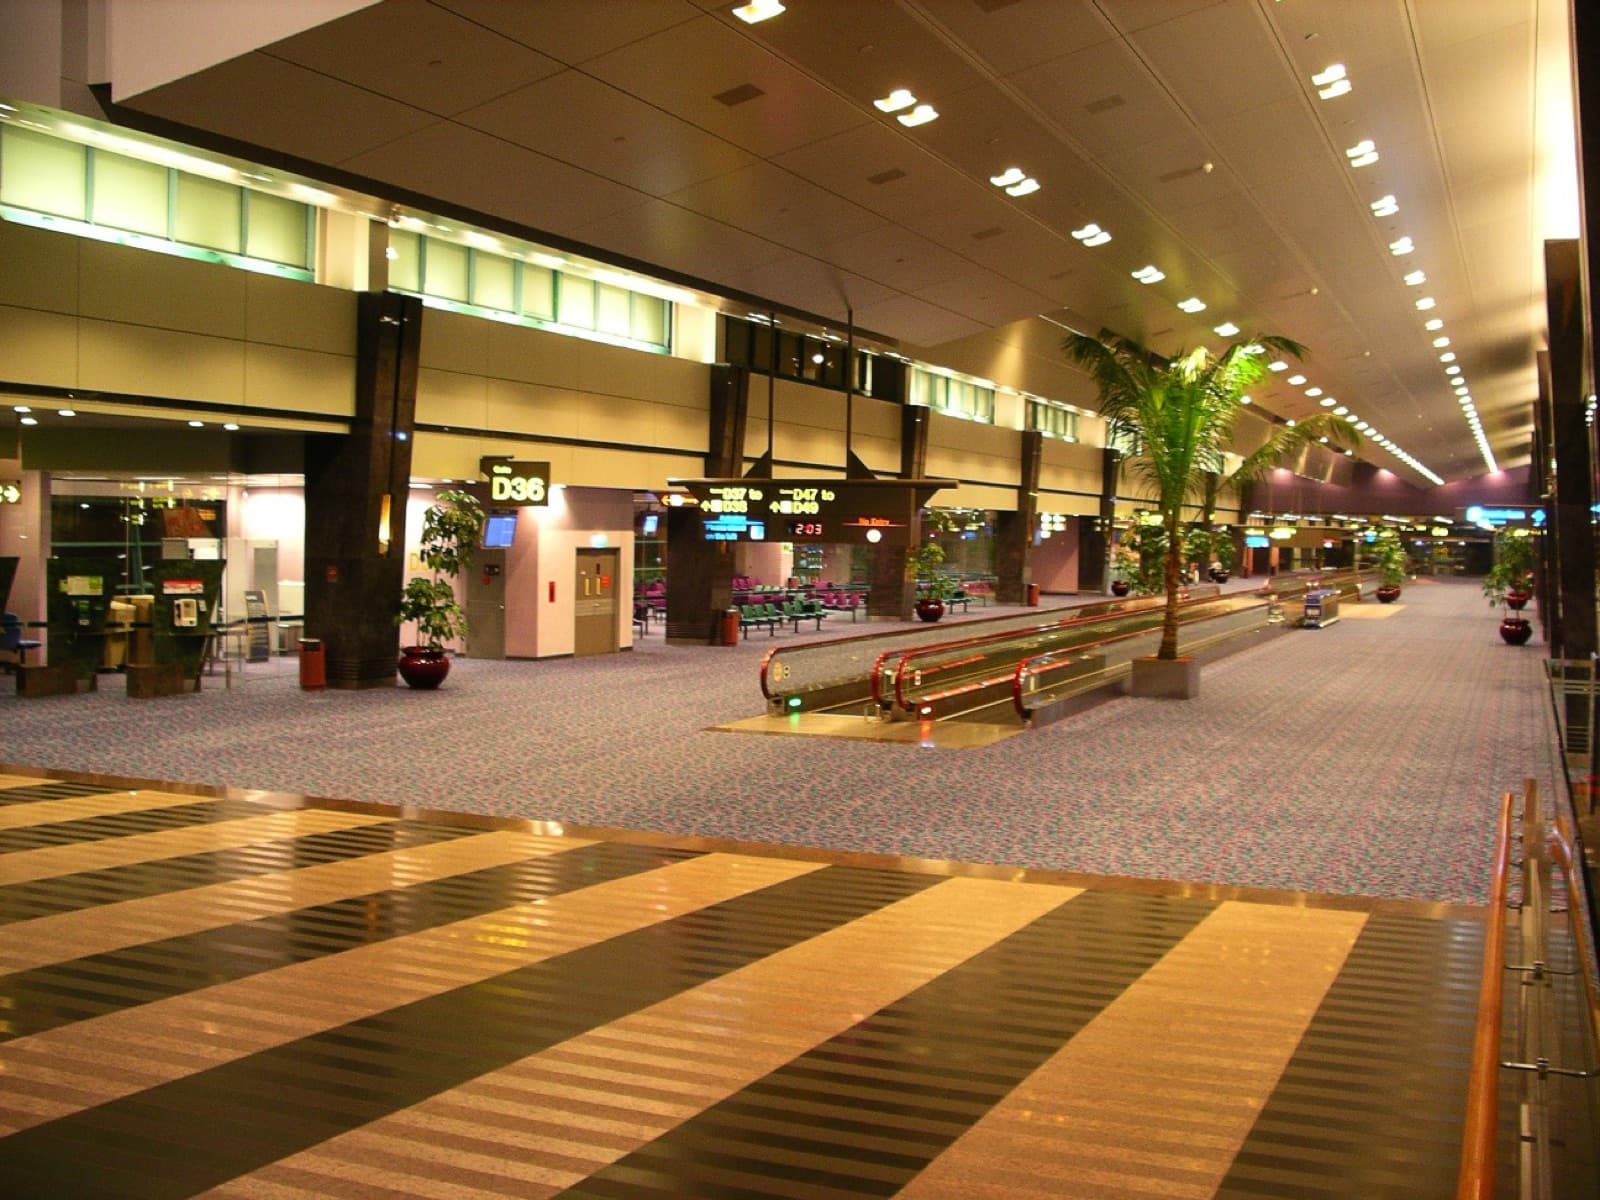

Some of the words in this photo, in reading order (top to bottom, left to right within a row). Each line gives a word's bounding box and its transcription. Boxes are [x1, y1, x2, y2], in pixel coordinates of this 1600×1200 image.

[492, 476, 545, 502] D36
[793, 489, 818, 501] D47
[821, 489, 835, 501] to
